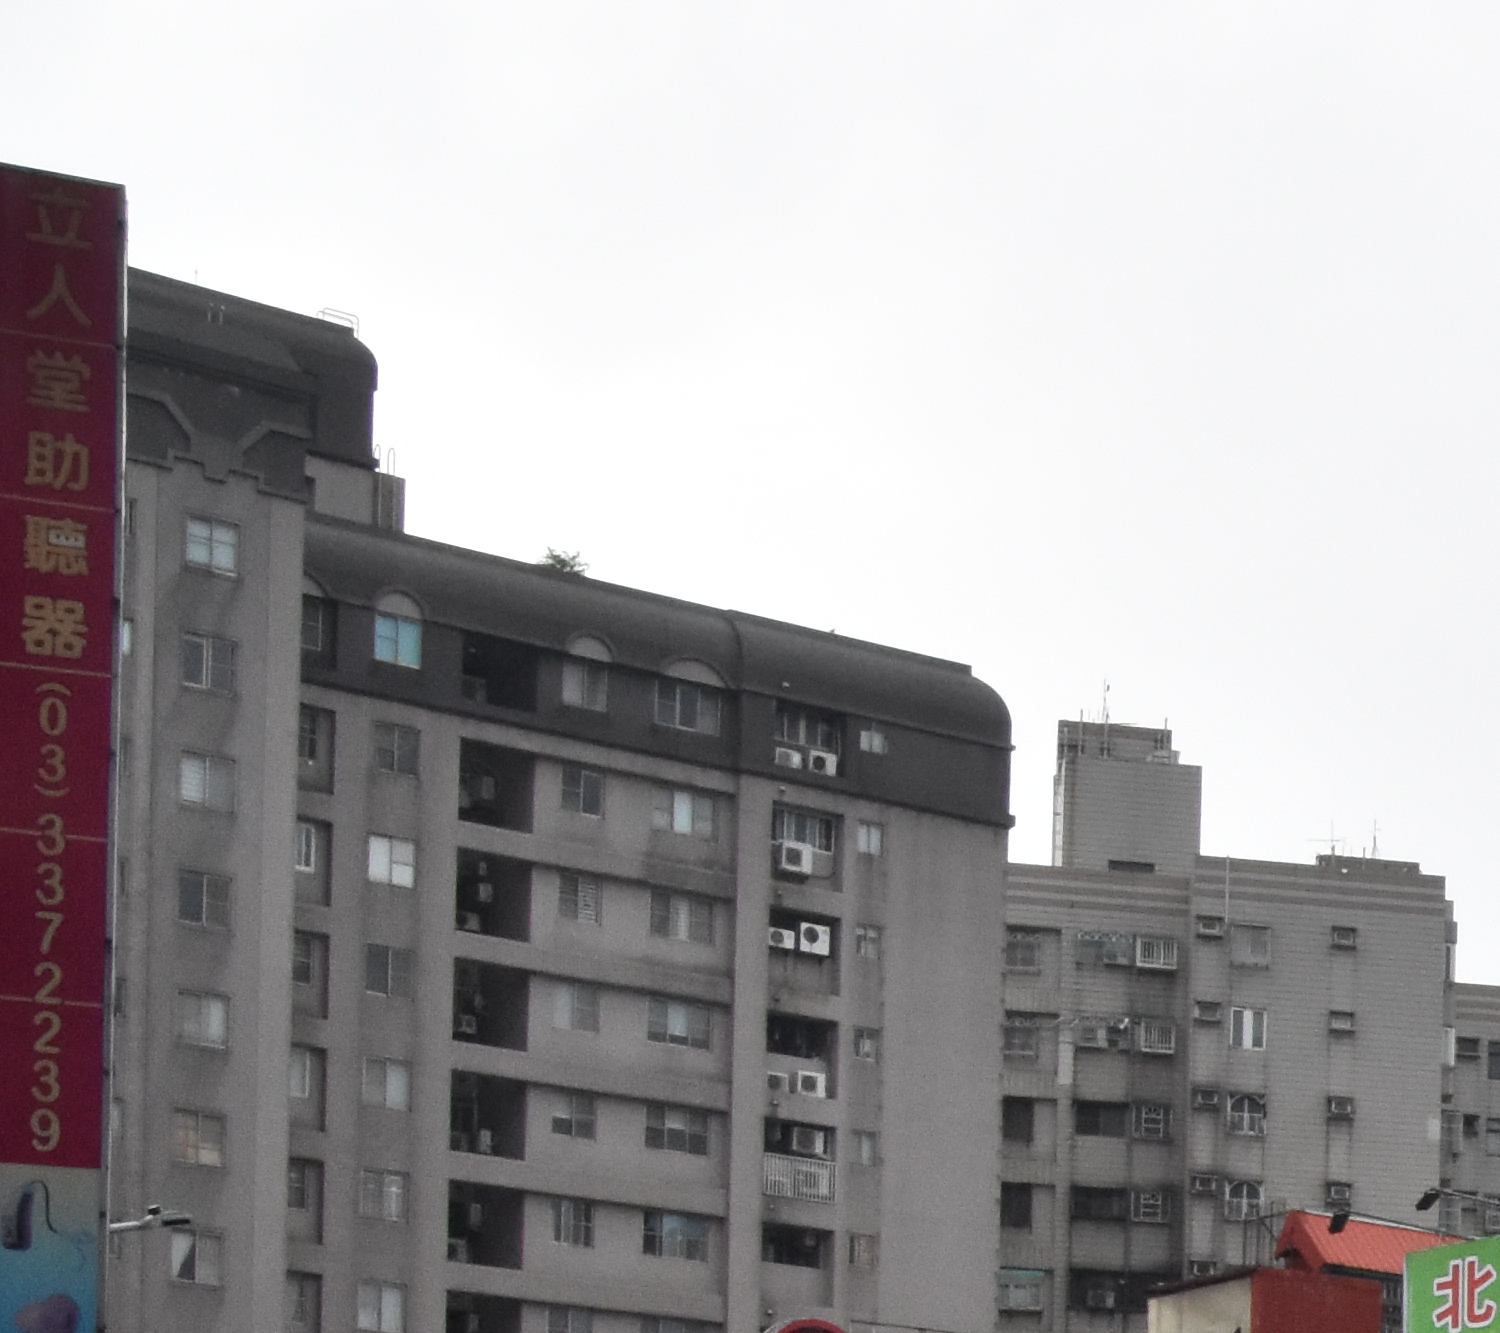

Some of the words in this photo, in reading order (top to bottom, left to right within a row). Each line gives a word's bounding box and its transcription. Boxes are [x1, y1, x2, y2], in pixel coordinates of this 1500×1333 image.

[21, 190, 94, 661] 立人堂助聽器
